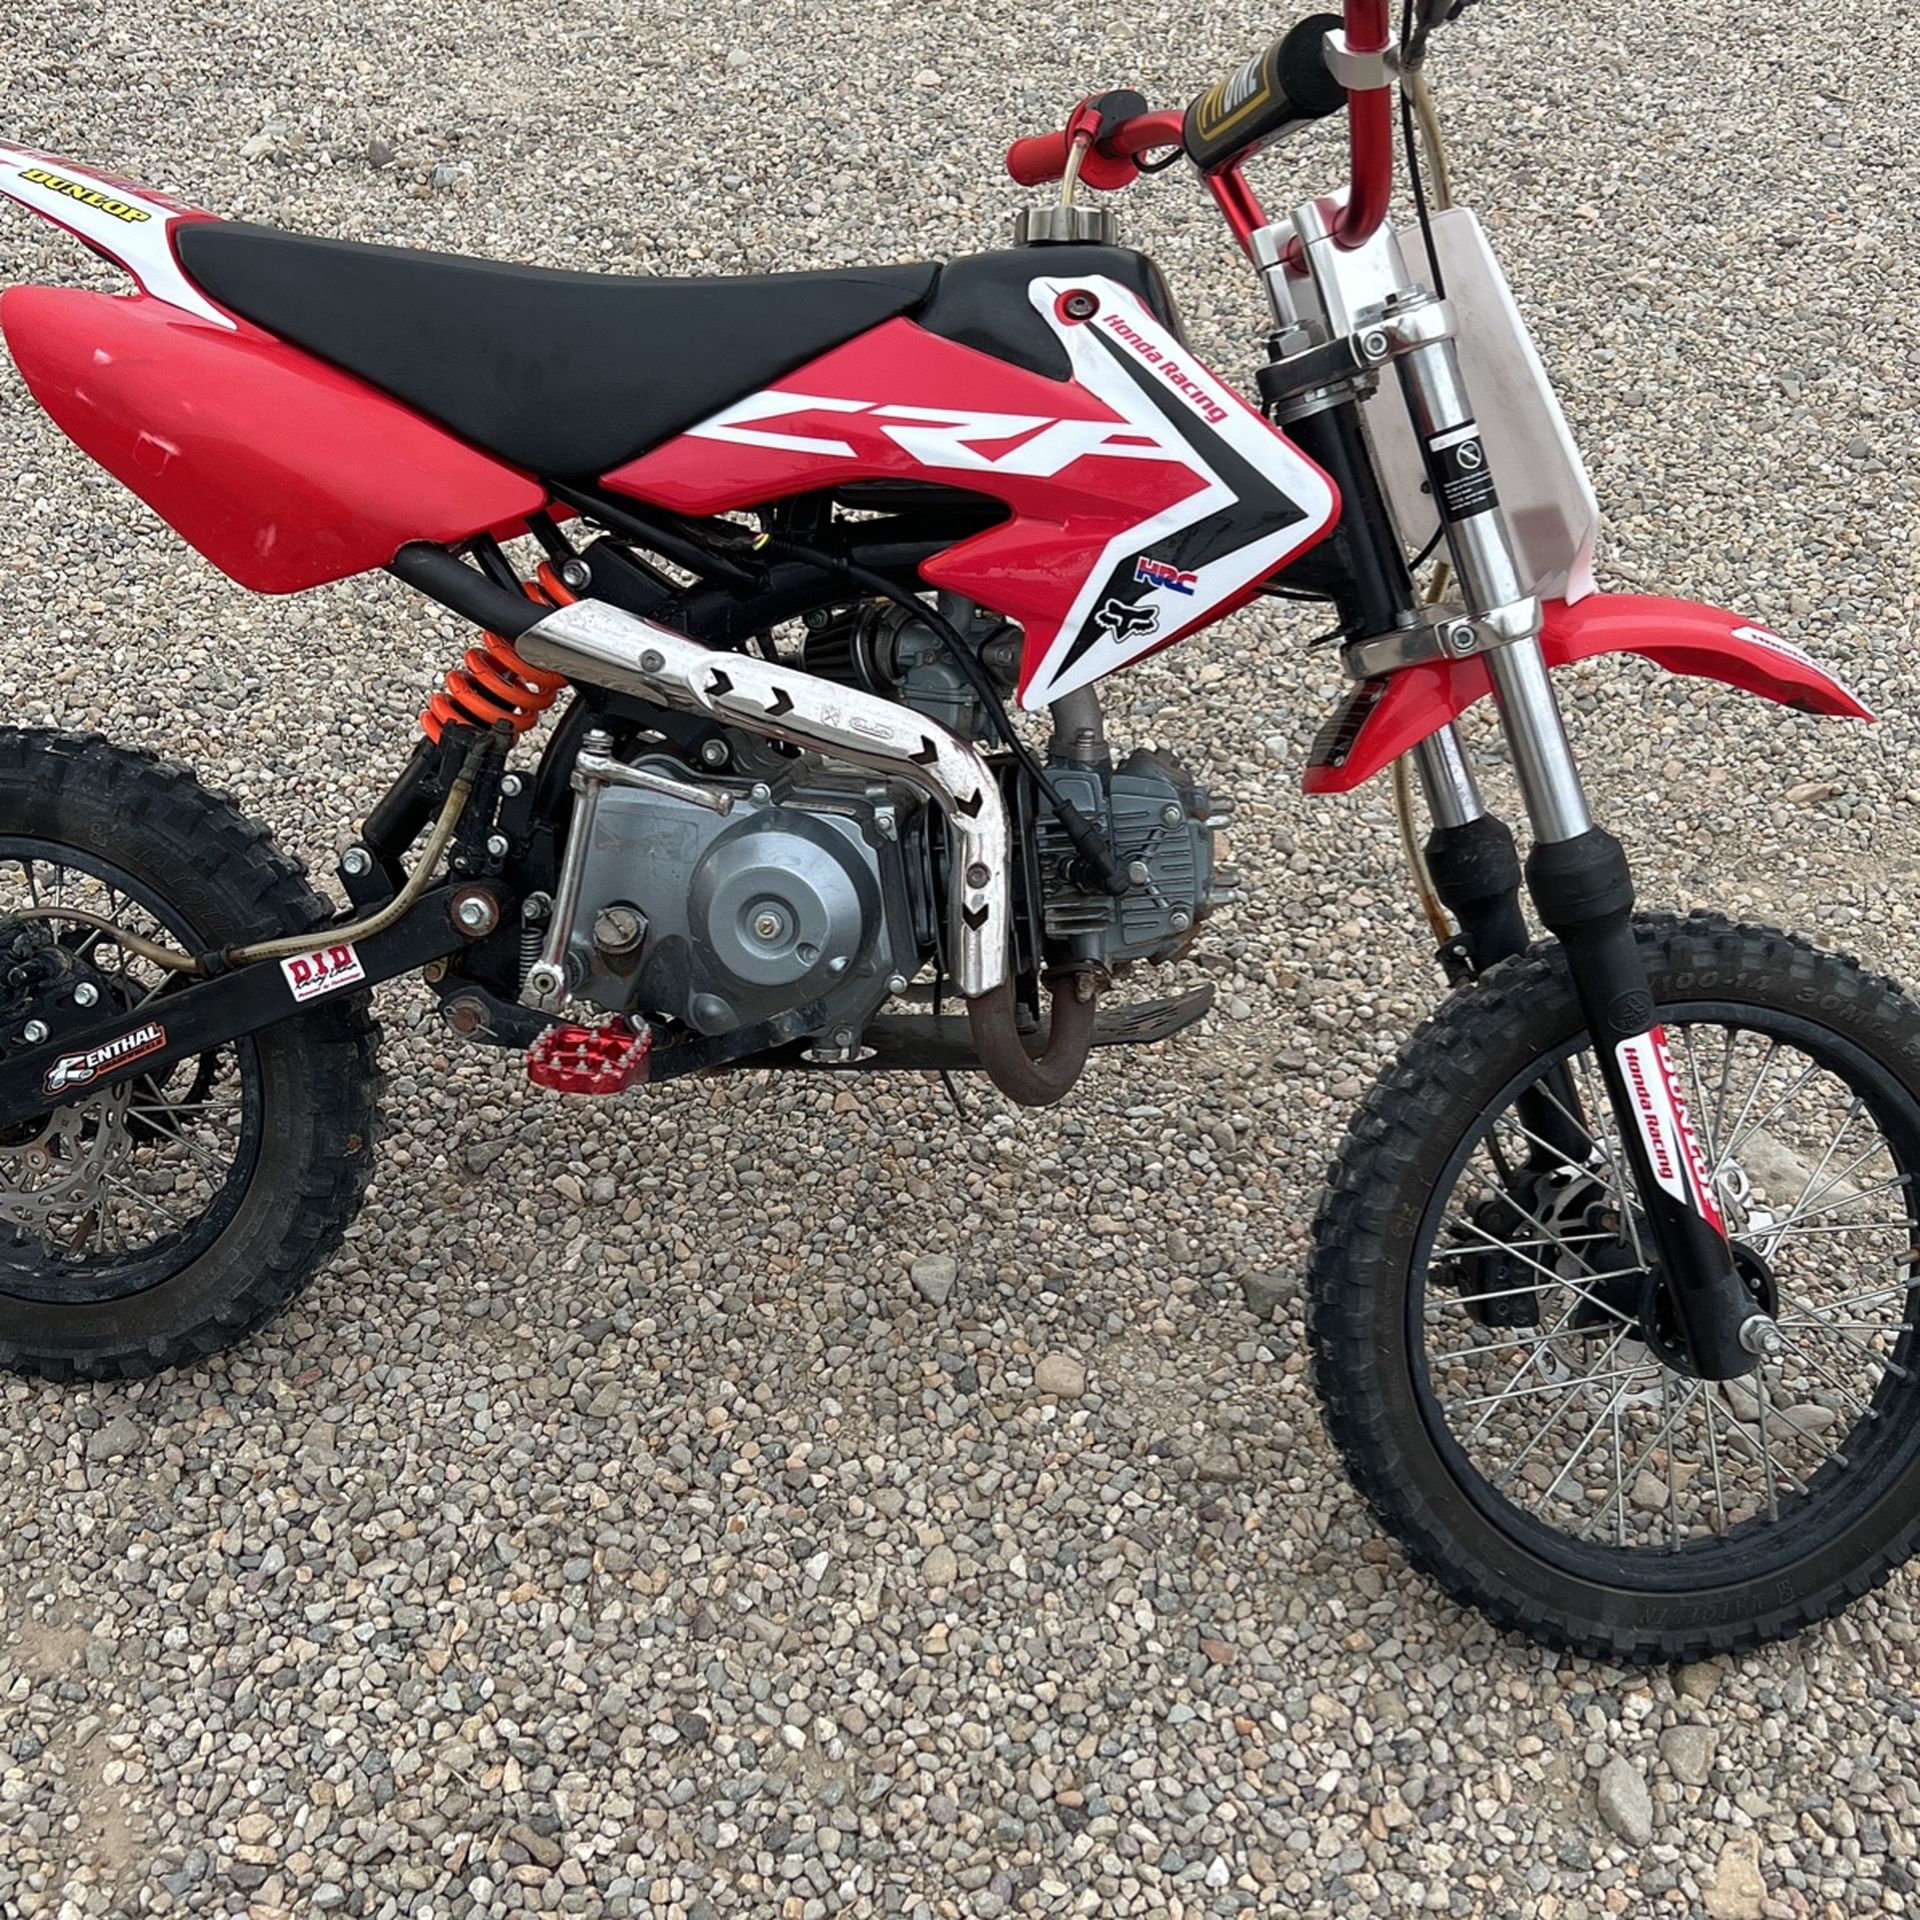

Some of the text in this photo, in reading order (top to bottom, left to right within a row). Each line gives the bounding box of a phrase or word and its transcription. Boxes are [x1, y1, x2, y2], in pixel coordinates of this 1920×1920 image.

[18, 168, 151, 223] DUNLOP
[1102, 313, 1230, 425] Honda Racing
[1133, 555, 1199, 597] HRC
[1623, 1047, 1653, 1111] Honda
[1644, 1113, 1675, 1180] Racing
